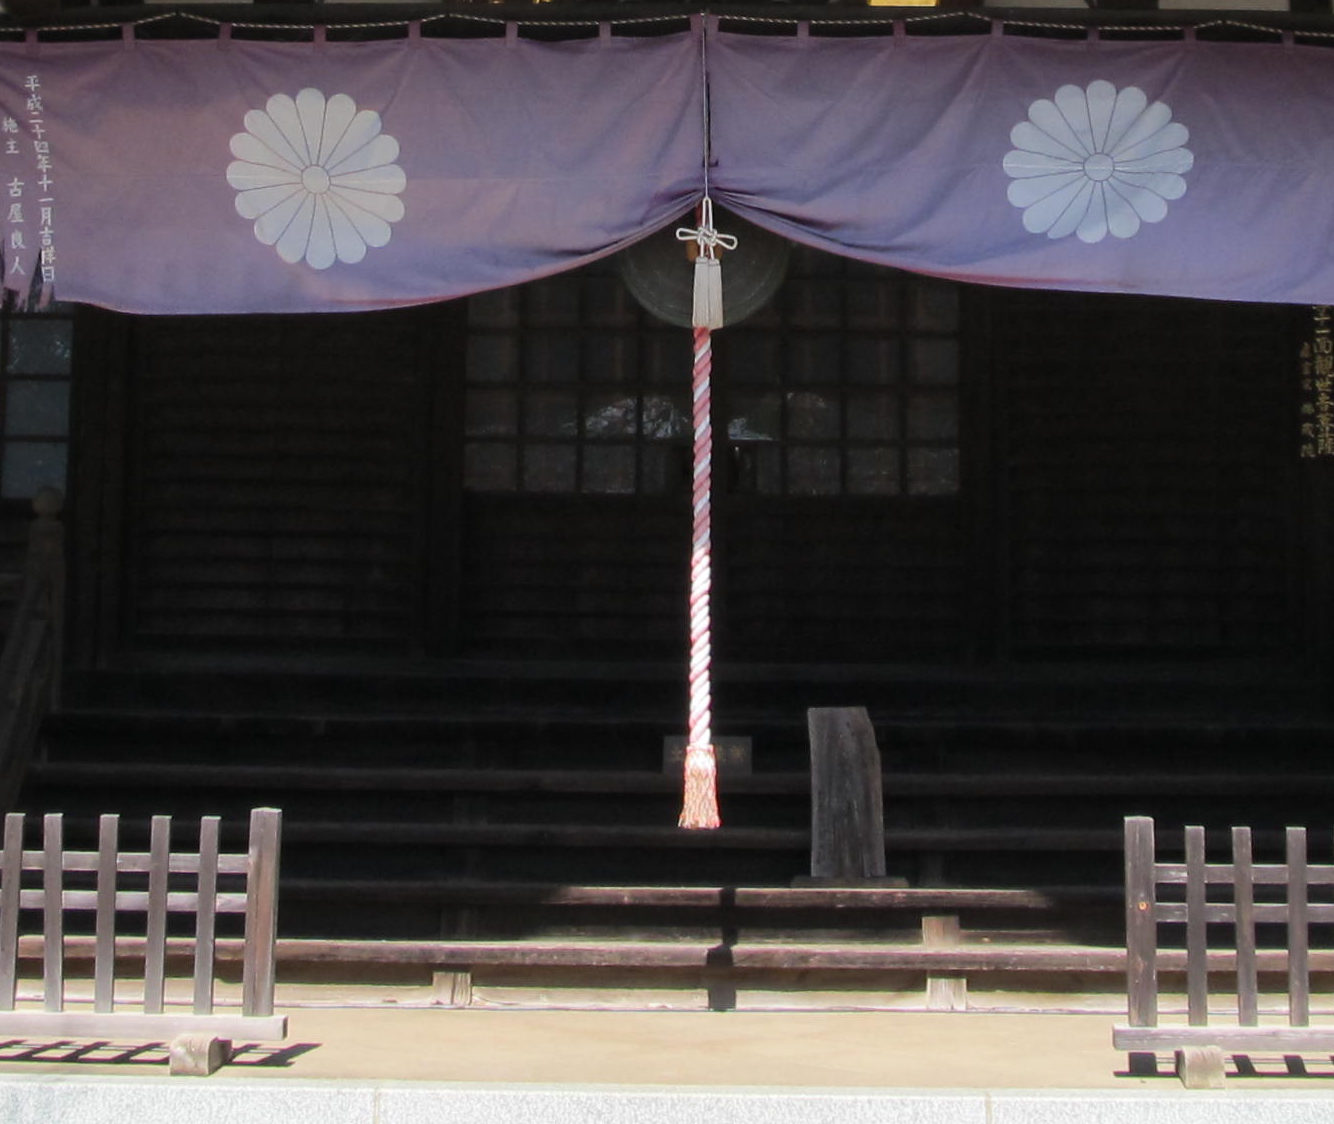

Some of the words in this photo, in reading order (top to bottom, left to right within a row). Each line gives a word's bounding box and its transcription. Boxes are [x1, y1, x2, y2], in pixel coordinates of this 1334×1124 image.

[2, 117, 19, 154] 施主
[7, 177, 25, 275] 古屋良人
